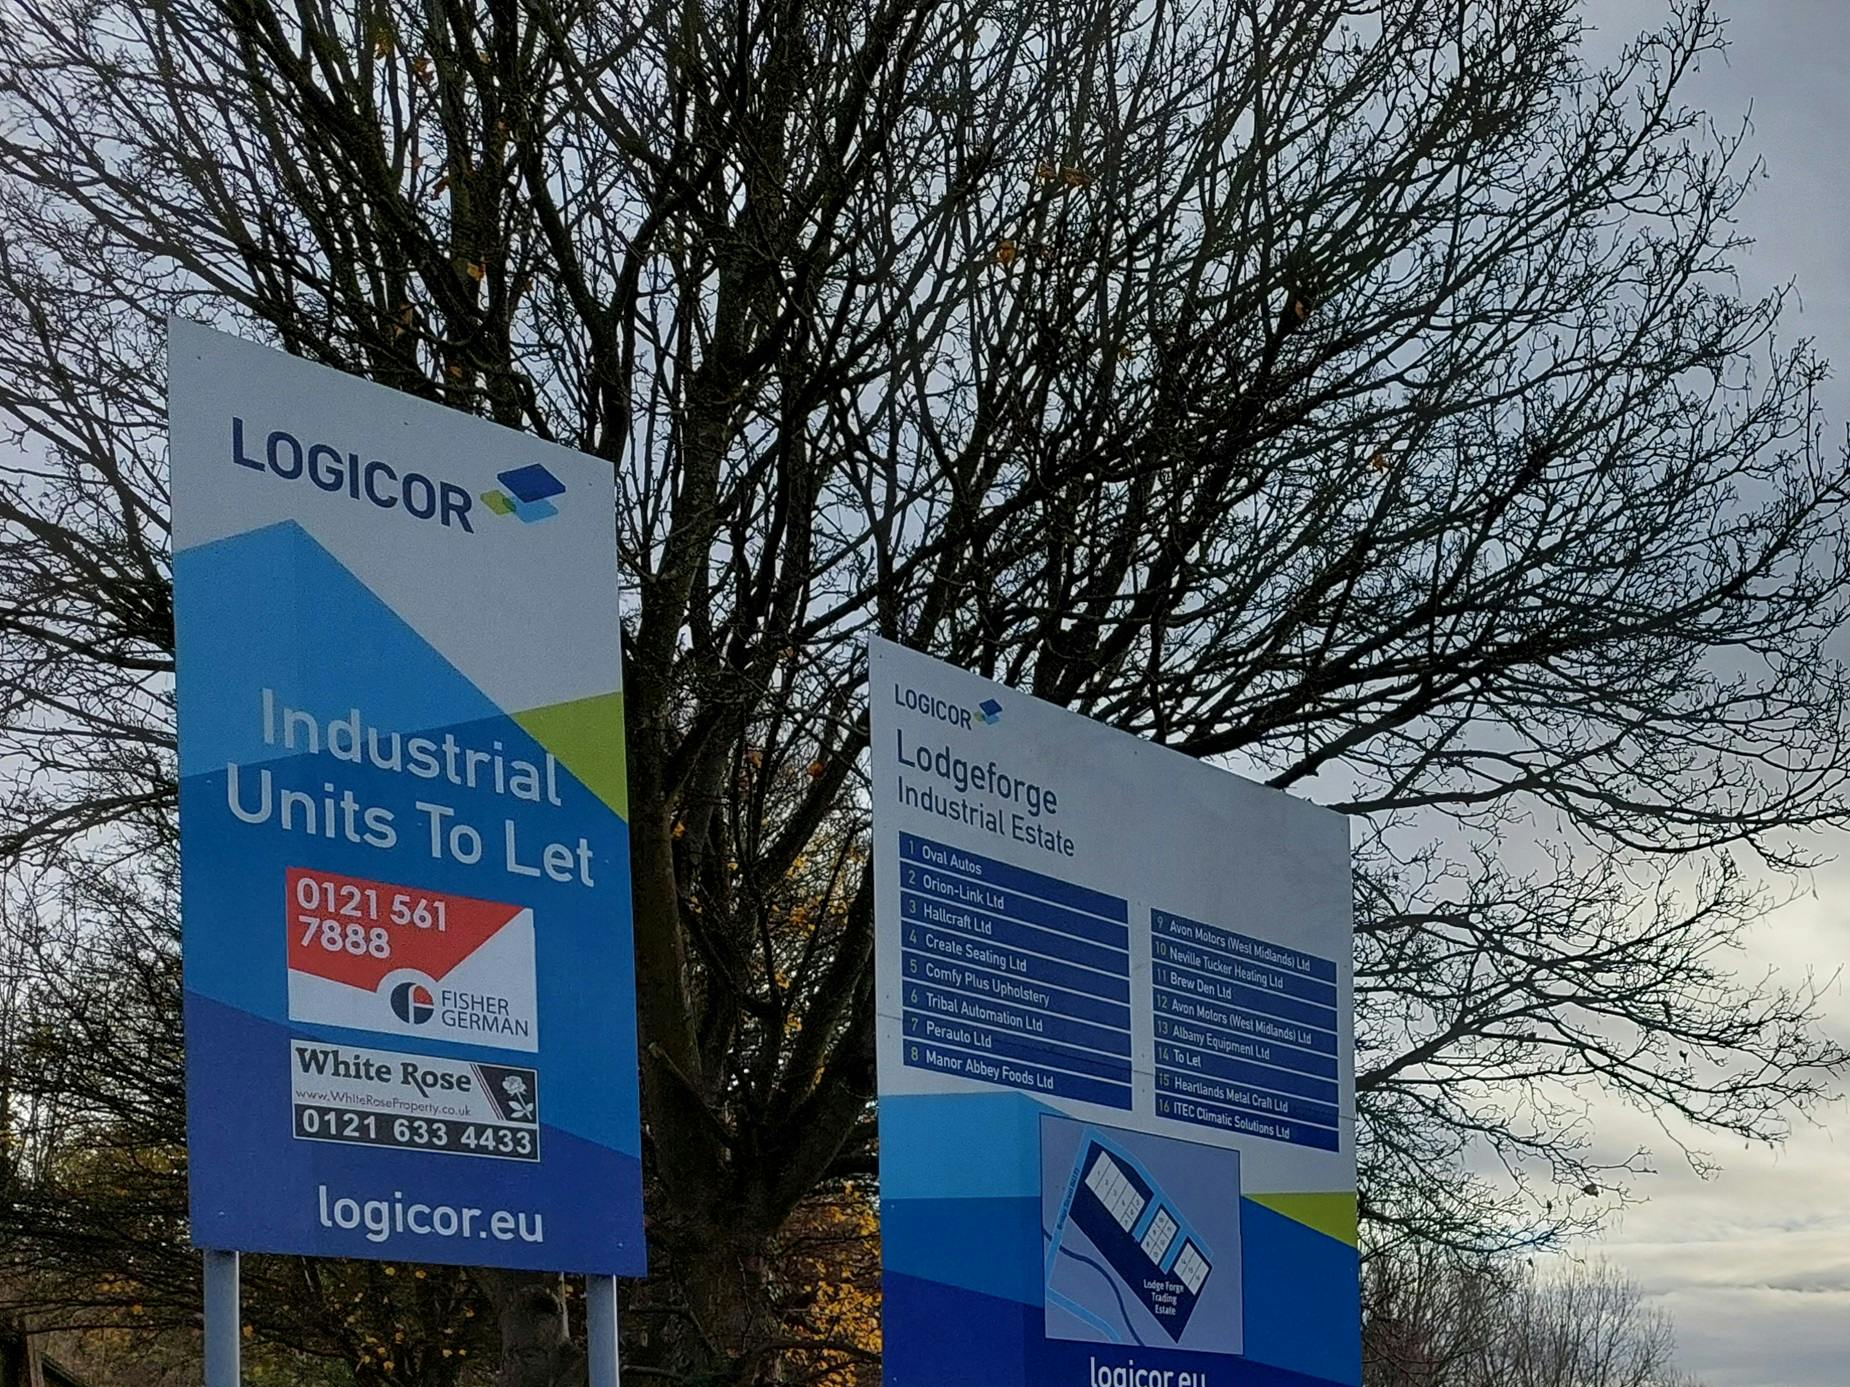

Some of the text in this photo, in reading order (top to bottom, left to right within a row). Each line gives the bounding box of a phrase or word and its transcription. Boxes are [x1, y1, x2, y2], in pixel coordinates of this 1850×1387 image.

[232, 417, 475, 534] LOGICOR
[895, 683, 972, 731] LOGICOR
[262, 687, 562, 807] Industrial
[897, 729, 1057, 817] Lodgeforge
[227, 763, 595, 888] Units To Let
[898, 776, 1075, 857] Industrial Estate
[909, 840, 982, 875] 1 Oval Autos
[297, 877, 446, 932] 0121 561
[908, 870, 1005, 910] 2 Orion-Link Ltd
[298, 915, 391, 959] 7888
[909, 900, 992, 935] 3 Hallcraft Ltd
[909, 929, 1027, 972] 4 Create Seating Ltd
[1155, 941, 1283, 989] 10 Neville Tucker Heating Ltd
[1157, 916, 1310, 972] 9 Avon Motors (West Midlands) Ltd
[441, 990, 510, 1016] FISHER
[910, 959, 1050, 1007] 5 Comfy Plus Upholstery
[1157, 968, 1231, 1000] 11 Brew Den Ltd
[441, 1009, 529, 1037] GERMAN
[910, 989, 1043, 1032] 6 Tribal Automation Ltd
[1157, 995, 1311, 1044] 12 Avon Motors (West Midlands) Ltd
[911, 1017, 992, 1048] 7 Perauto Ltd
[1157, 1020, 1270, 1060] 13 Albany Equipment Ltd
[295, 1047, 472, 1098] White Rose
[911, 1047, 1054, 1089] 8 Manor Abbey Foods Ltd
[1159, 1047, 1201, 1067] 14 To Let
[295, 1089, 472, 1117] www.WhiteRoseProperty.co.uk
[1159, 1072, 1169, 1086] 15
[1175, 1077, 1224, 1099] Heartlands
[1226, 1089, 1250, 1105] Metal
[1274, 1099, 1288, 1112] Ltd
[303, 1109, 531, 1154] 0121 633 4433
[1159, 1099, 1290, 1139] 16 ITEC Climatic Solutions Ltd
[318, 1185, 544, 1243] logicor.eu
[1144, 1279, 1164, 1291] Lodge
[1152, 1292, 1177, 1305] Trading
[1155, 1304, 1176, 1316] Estate
